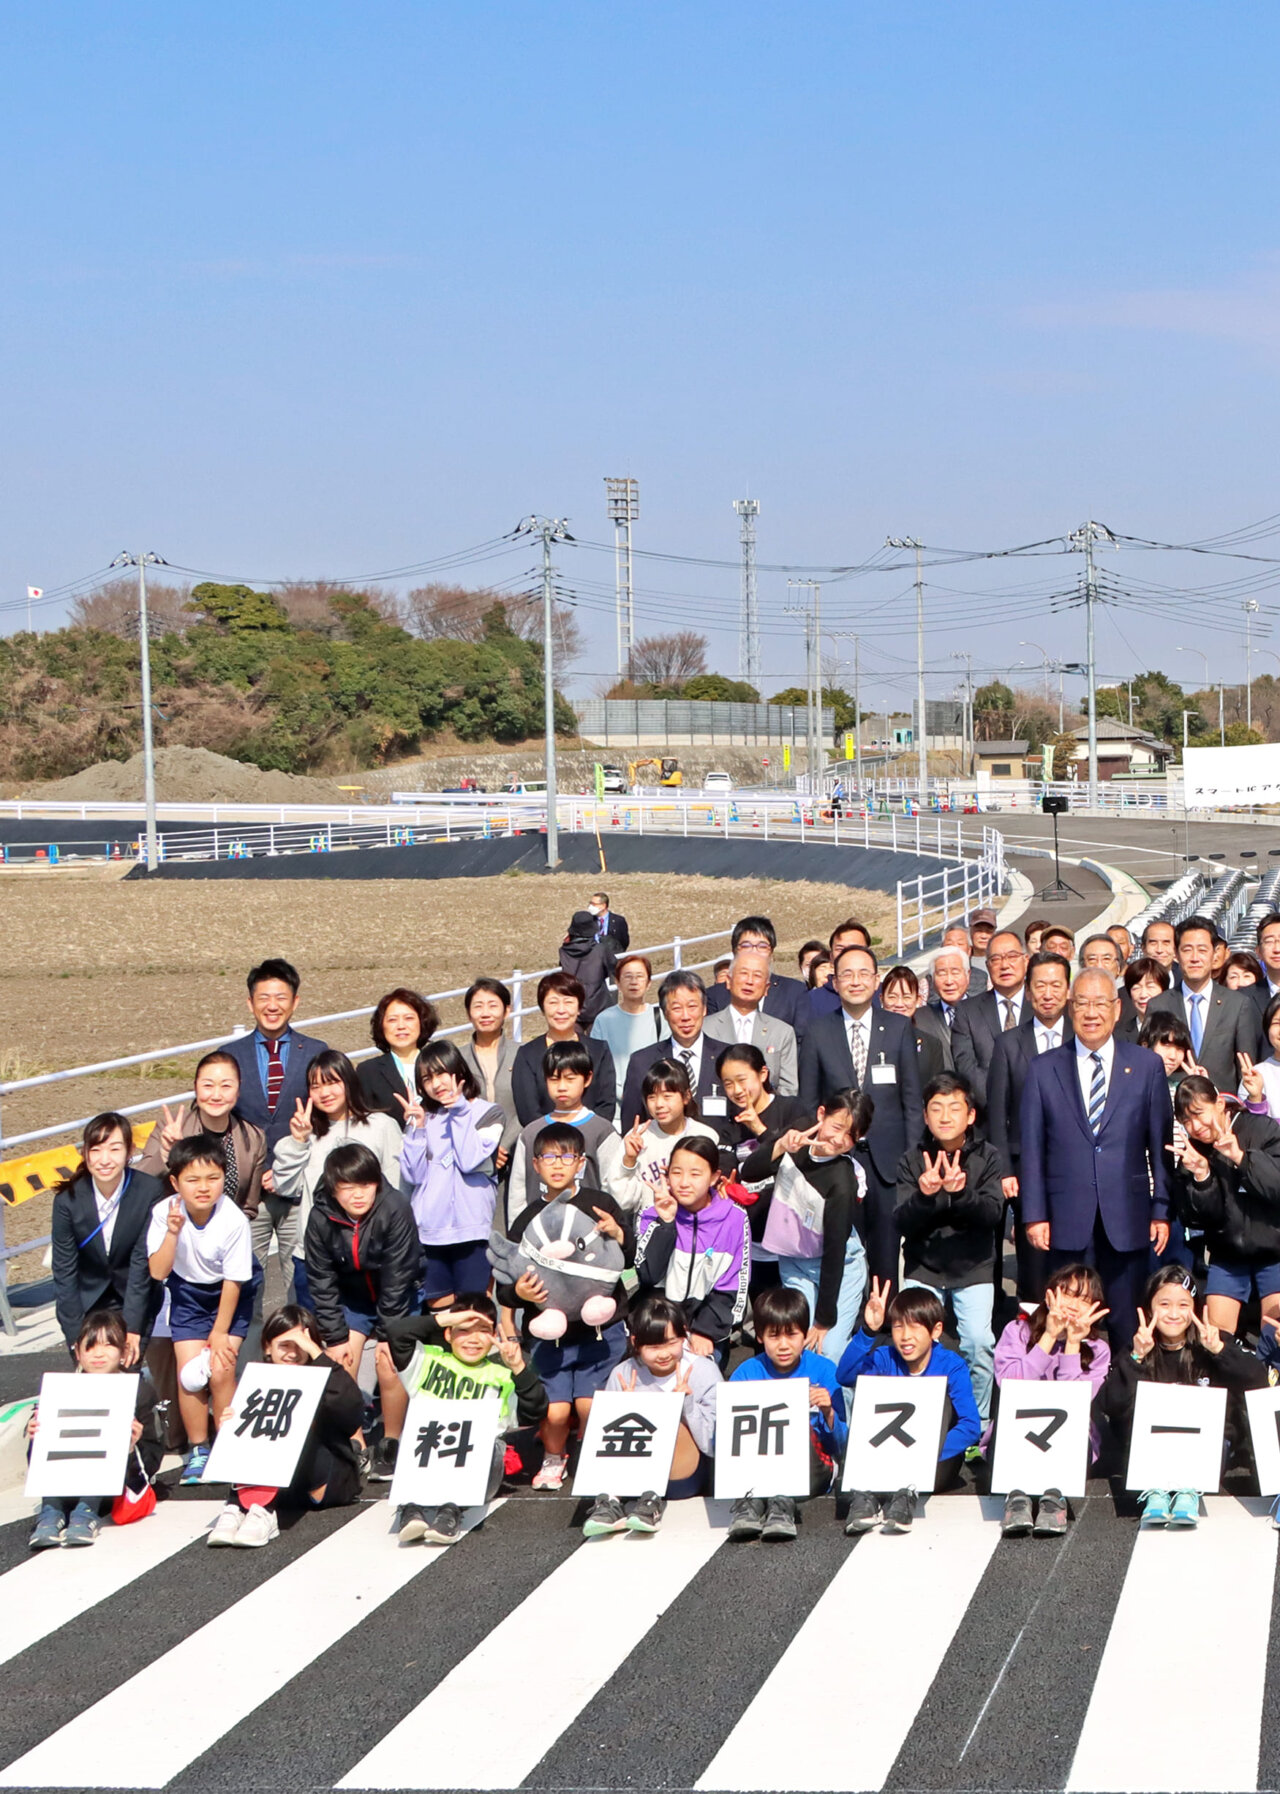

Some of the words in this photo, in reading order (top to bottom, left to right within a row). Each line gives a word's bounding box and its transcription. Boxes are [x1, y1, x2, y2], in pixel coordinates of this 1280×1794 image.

[738, 1268, 749, 1295] HOPE
[46, 1409, 111, 1461] 三
[234, 1388, 303, 1442] 郷
[595, 1412, 658, 1458] 金
[731, 1402, 790, 1457] 所
[869, 1402, 916, 1448] ス
[1015, 1408, 1068, 1453] マ
[414, 1420, 474, 1468] 料
